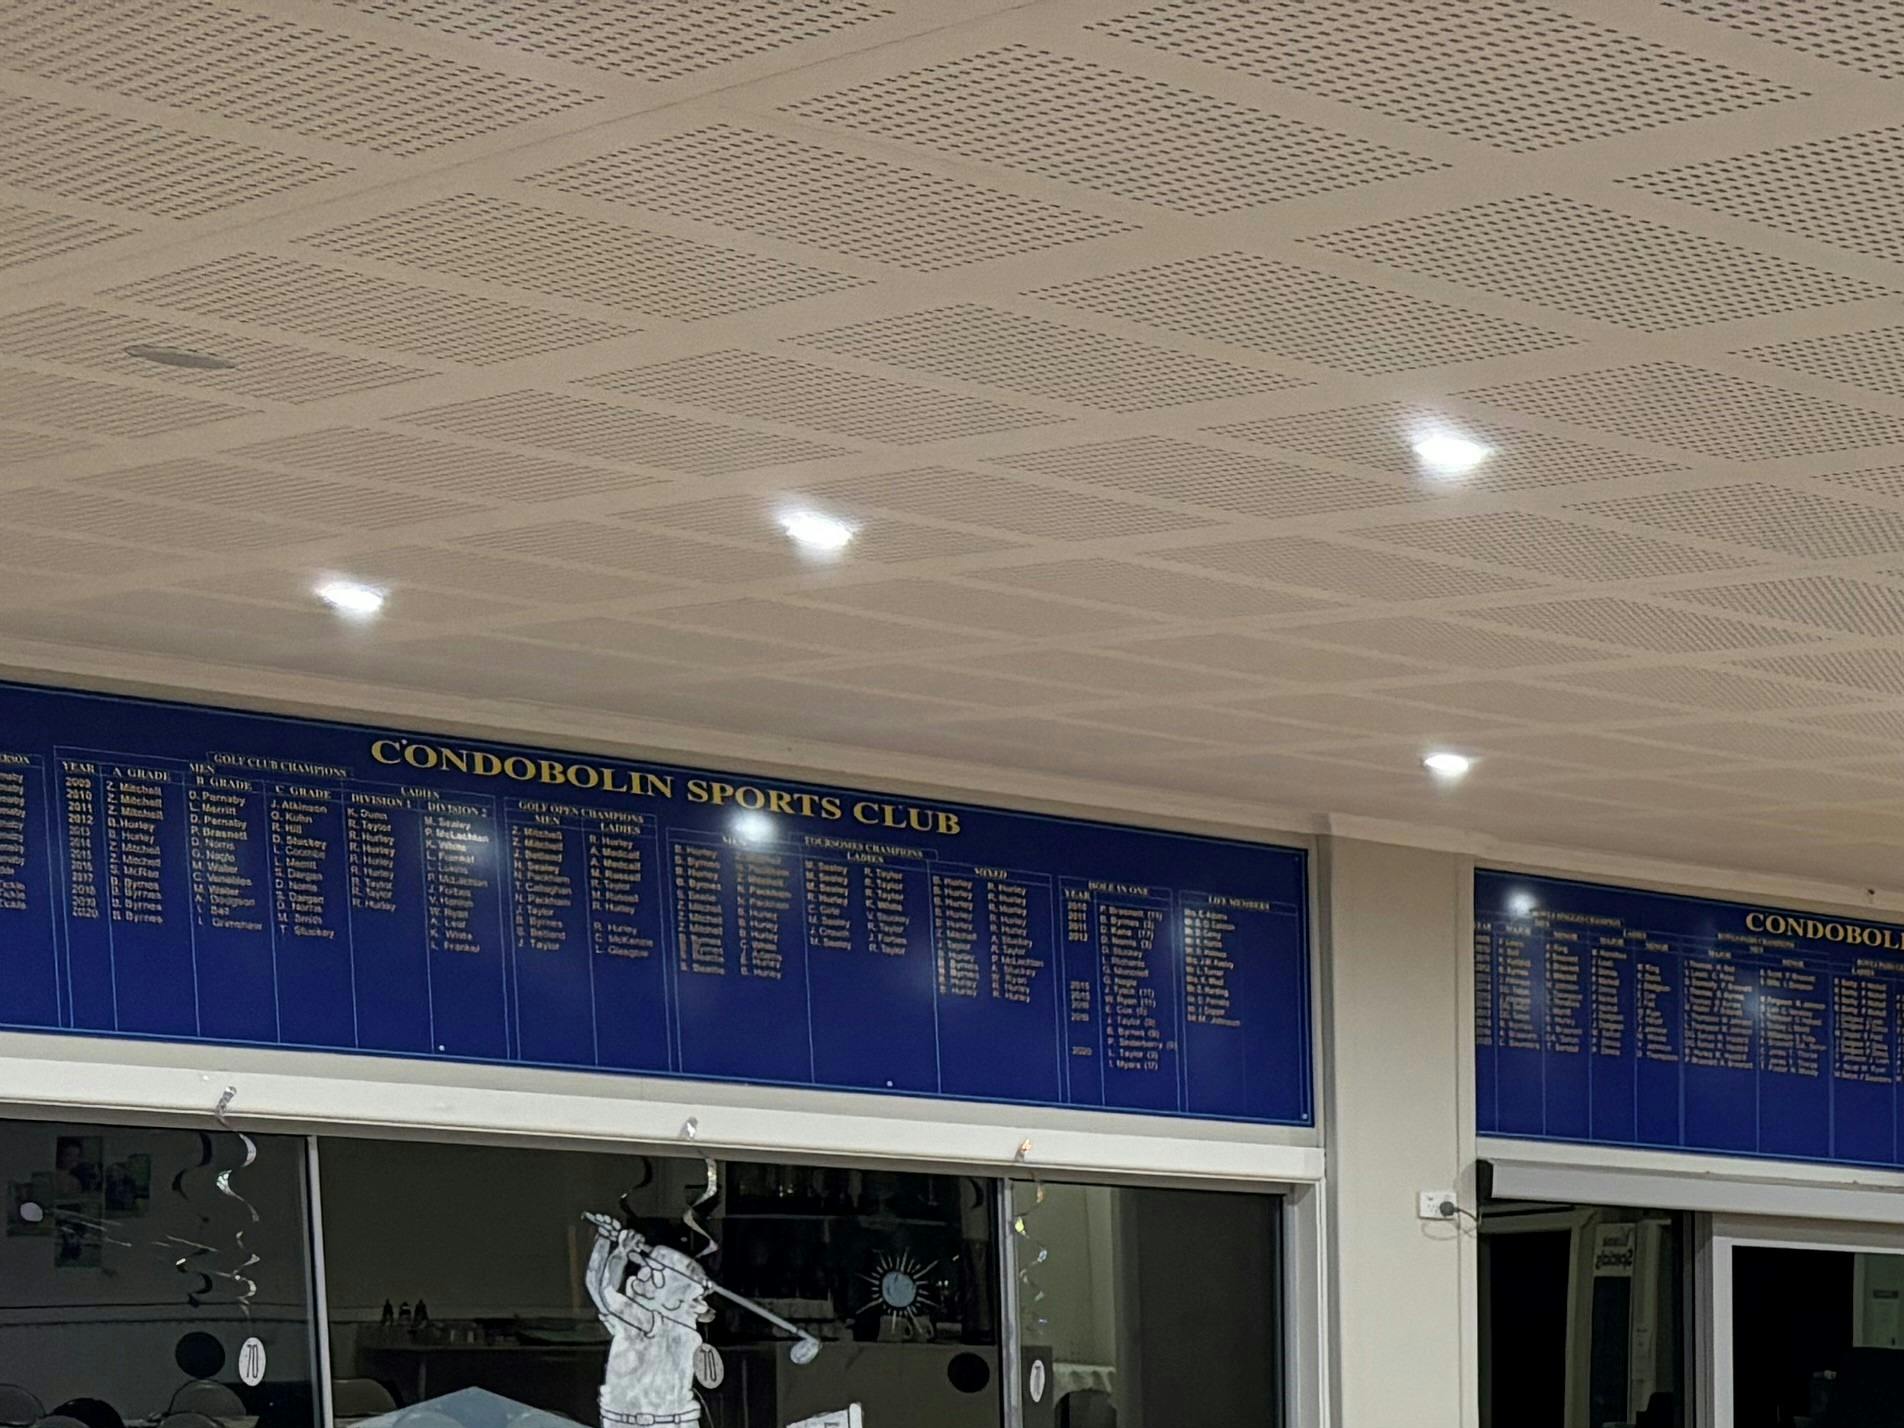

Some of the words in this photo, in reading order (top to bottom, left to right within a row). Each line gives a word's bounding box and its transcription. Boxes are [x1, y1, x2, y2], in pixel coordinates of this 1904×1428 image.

[62, 762, 95, 773] YEAR
[281, 762, 347, 777] CHAMPIONS
[128, 769, 170, 781] GRADE
[211, 778, 252, 791] GRADE
[370, 739, 674, 800] CONDOBOLIN
[687, 779, 842, 820] SPORTS
[852, 802, 962, 836] CLUB
[290, 787, 331, 799] GRADE
[352, 793, 403, 807] DIVISION
[428, 802, 478, 816] DIVISION
[69, 814, 94, 825] 2012
[601, 823, 640, 834] LADIES
[246, 1344, 259, 1379] 70
